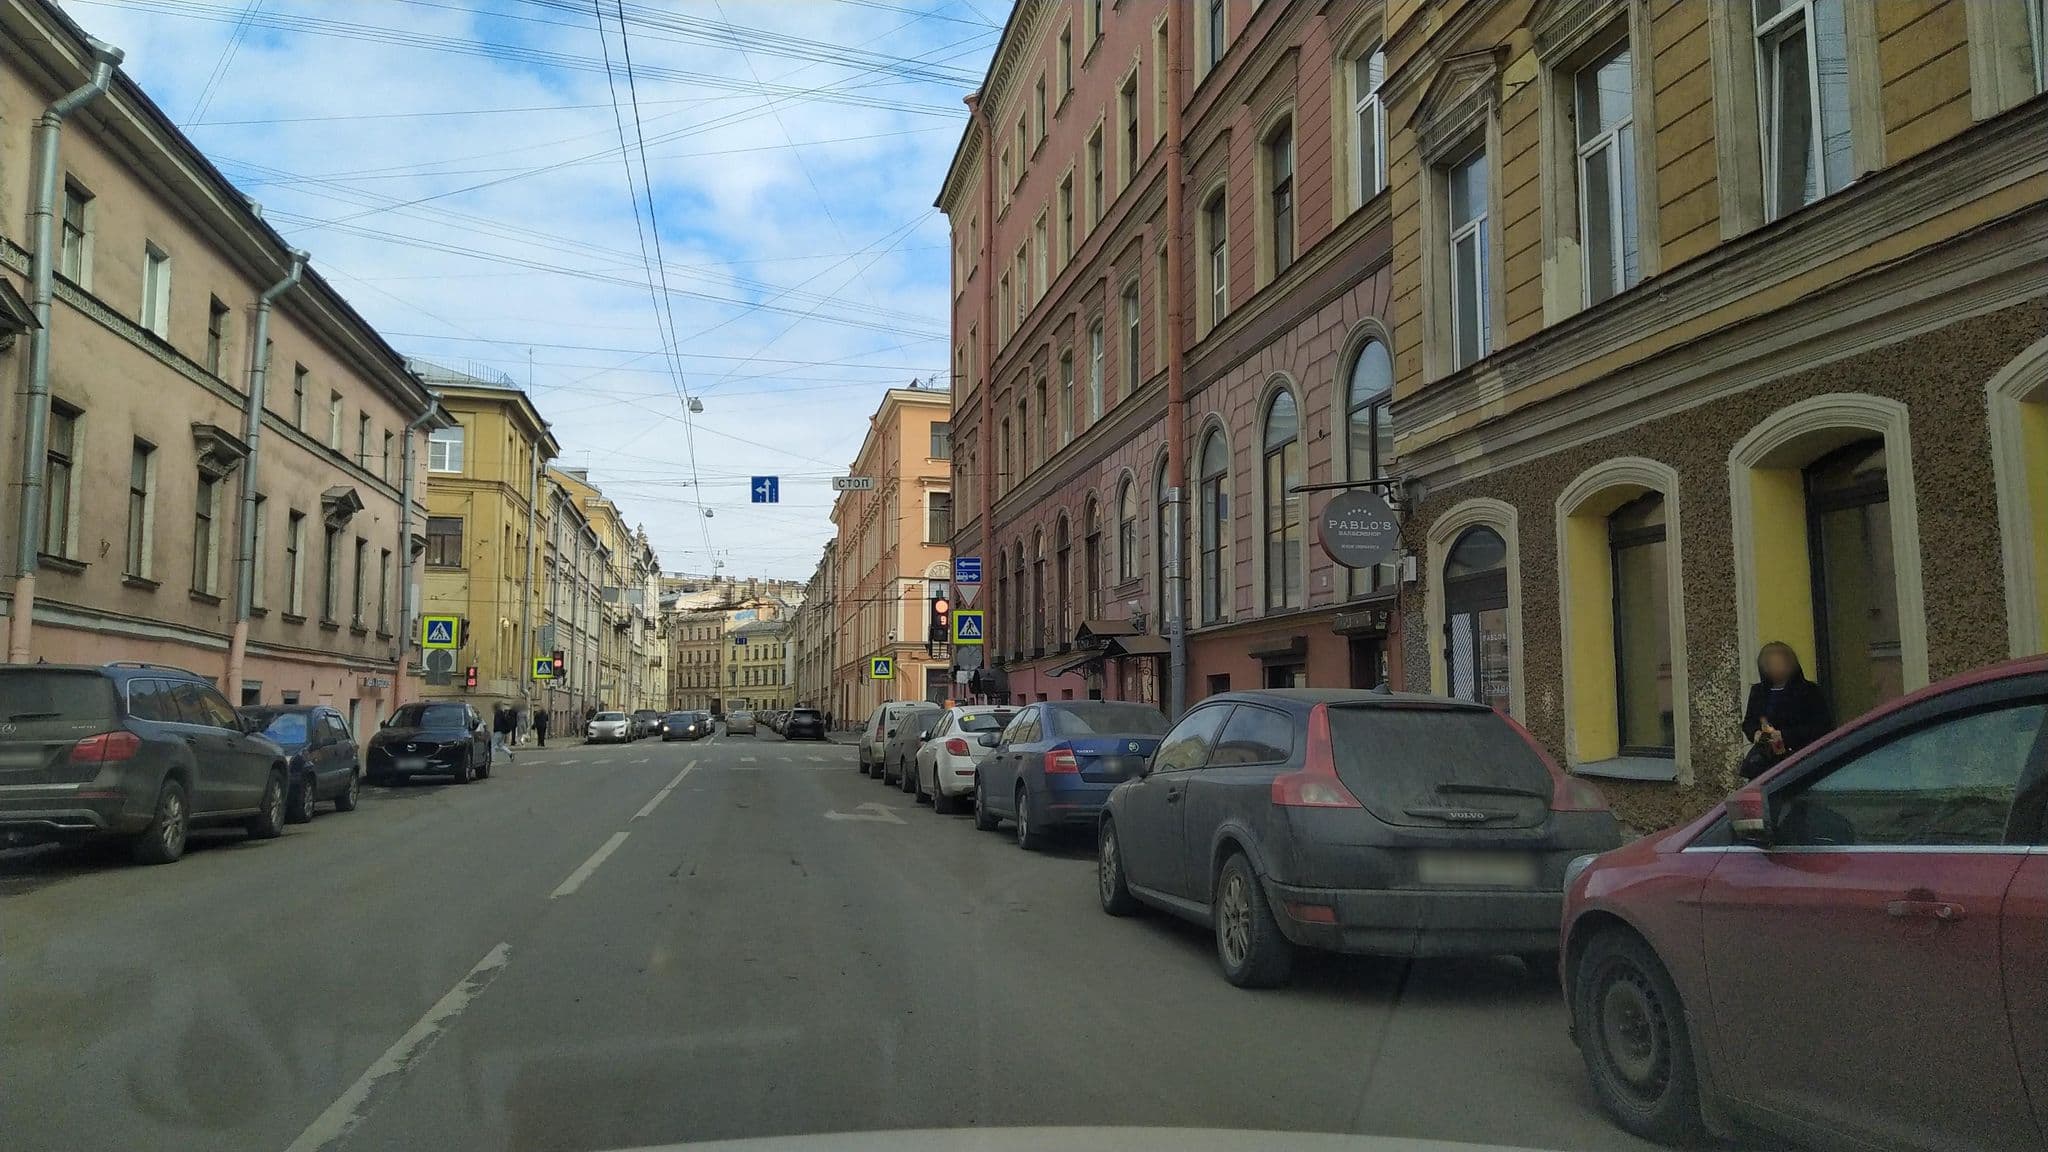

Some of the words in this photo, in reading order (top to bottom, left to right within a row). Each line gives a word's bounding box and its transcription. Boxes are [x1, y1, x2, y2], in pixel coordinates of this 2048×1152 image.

[838, 479, 869, 488] СТОП
[1328, 519, 1392, 530] PABLO'S
[940, 615, 947, 626] 9
